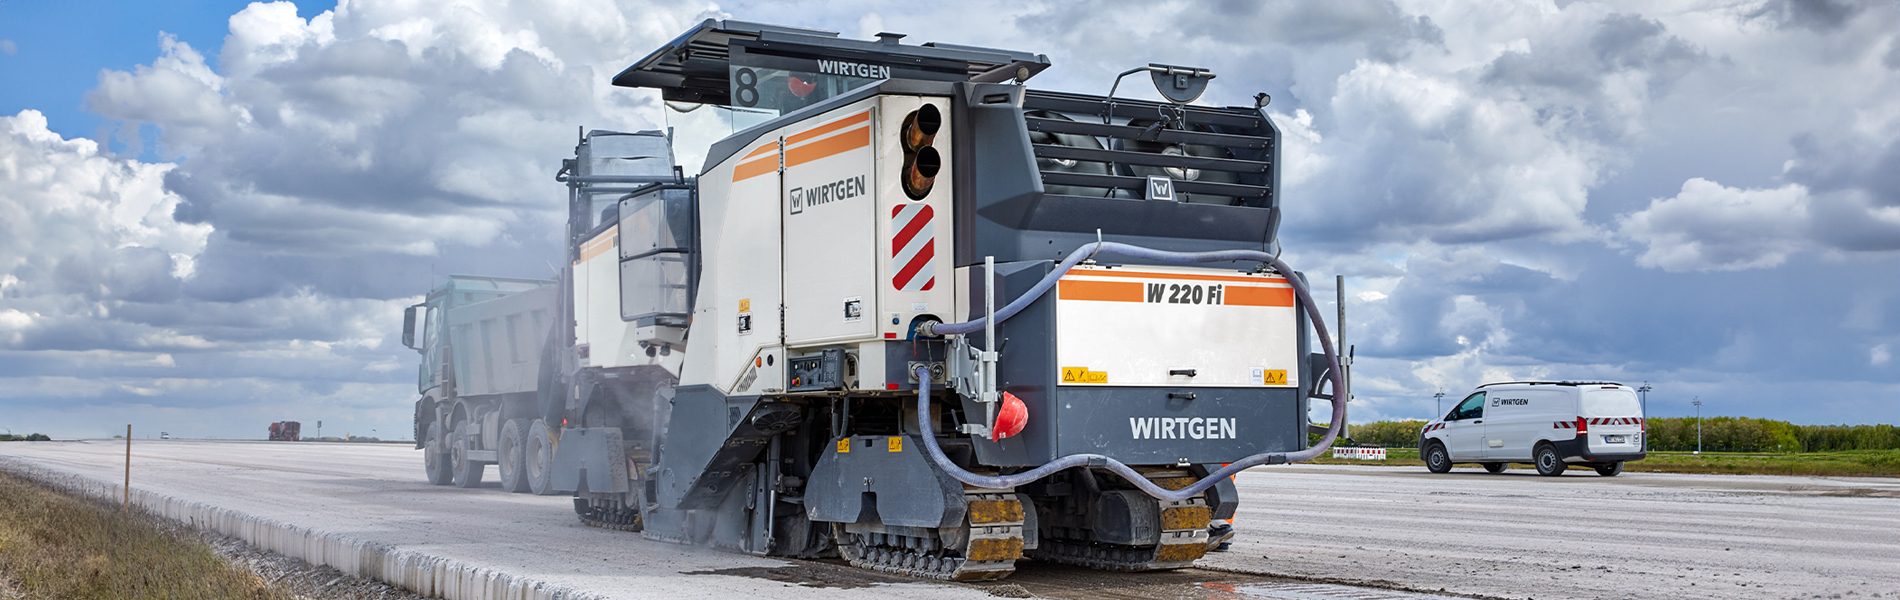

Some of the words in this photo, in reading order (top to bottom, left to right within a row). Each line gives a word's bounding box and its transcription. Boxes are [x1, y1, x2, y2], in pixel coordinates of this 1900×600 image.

[817, 59, 890, 79] WIRTGEN
[735, 68, 759, 107] 8
[806, 175, 865, 207] WIRTGEN
[1147, 283, 1166, 303] W
[1168, 284, 1203, 305] 220
[1207, 284, 1222, 305] Fi
[1129, 417, 1236, 440] WIRTGEN
